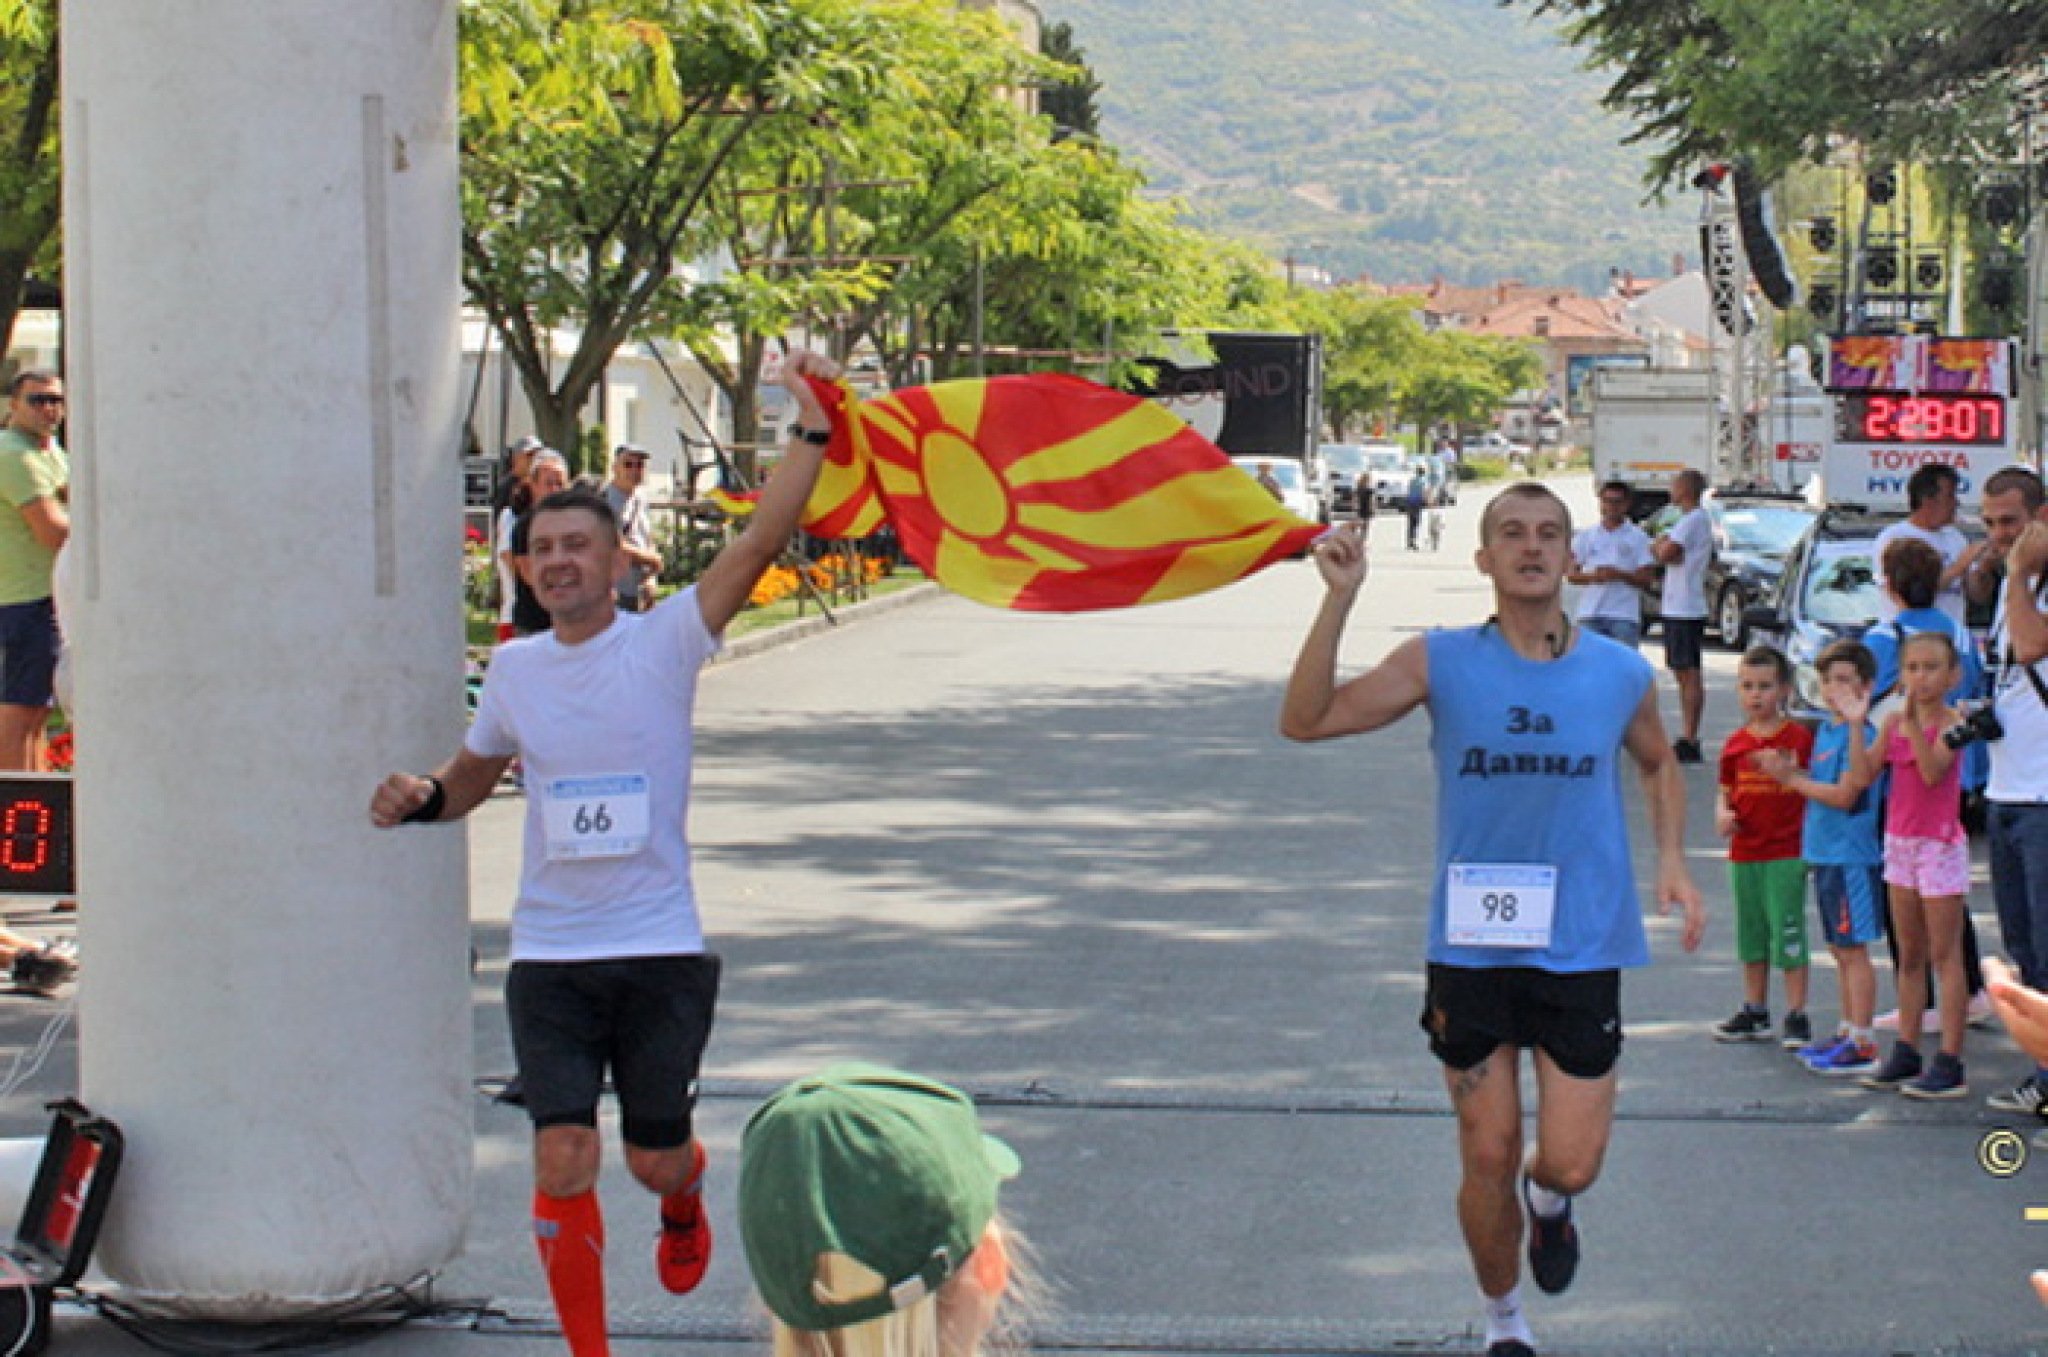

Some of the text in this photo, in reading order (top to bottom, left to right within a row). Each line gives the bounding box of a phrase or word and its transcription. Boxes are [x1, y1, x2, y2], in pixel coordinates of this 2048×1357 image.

[1868, 450, 1970, 469] TOYOTA
[1866, 476, 1971, 493] HYD
[1506, 705, 1554, 734] За
[574, 803, 612, 834] 66
[1482, 892, 1519, 922] 98
